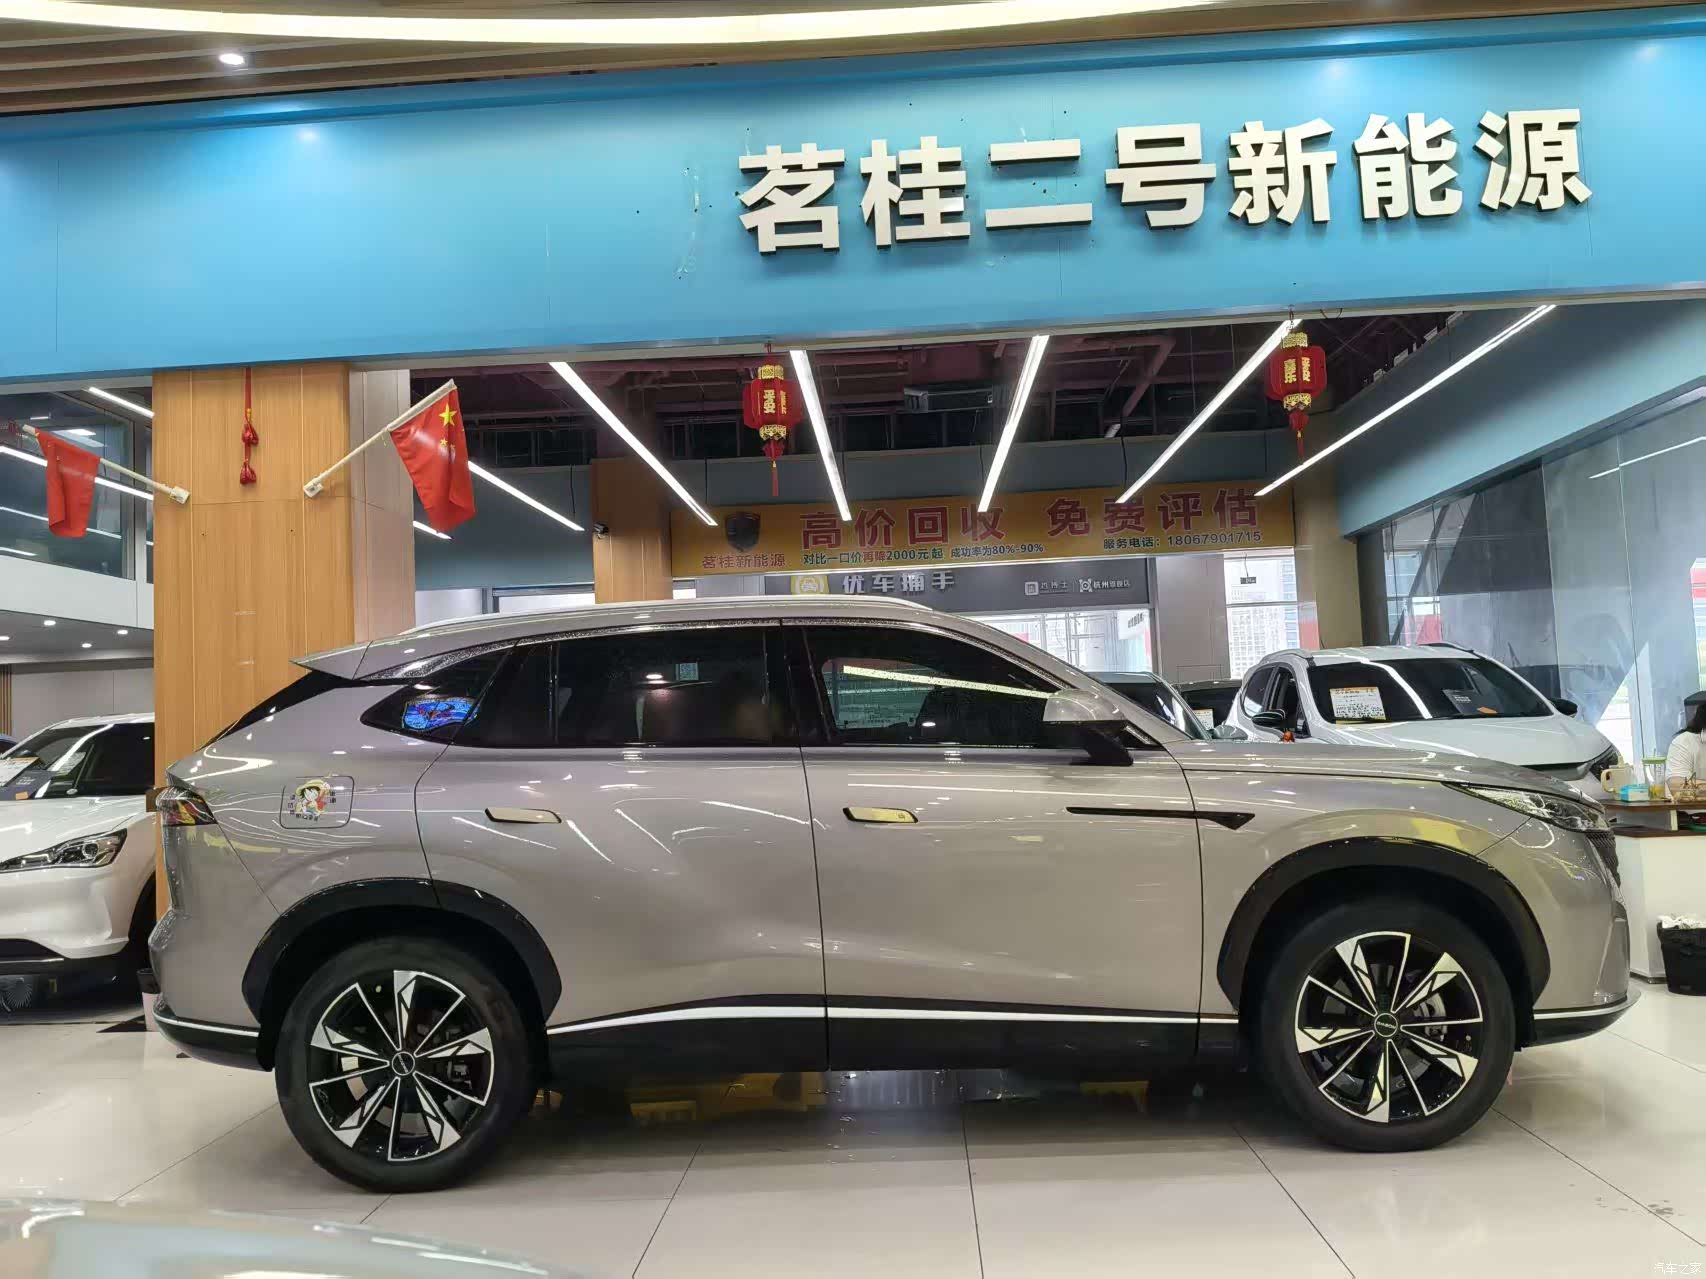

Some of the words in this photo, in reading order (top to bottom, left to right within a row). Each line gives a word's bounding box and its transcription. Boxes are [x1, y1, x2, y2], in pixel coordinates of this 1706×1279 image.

[737, 108, 1592, 254] 茗桂二号新能源
[800, 504, 1007, 550] 高价回收
[1047, 487, 1259, 537] 免费评估
[1167, 530, 1262, 547] 18067901715
[702, 552, 785, 569] 茗桂新能源
[803, 547, 944, 565] 对比一口价再降2000元起
[951, 543, 1044, 558] 成功率为80%-90%
